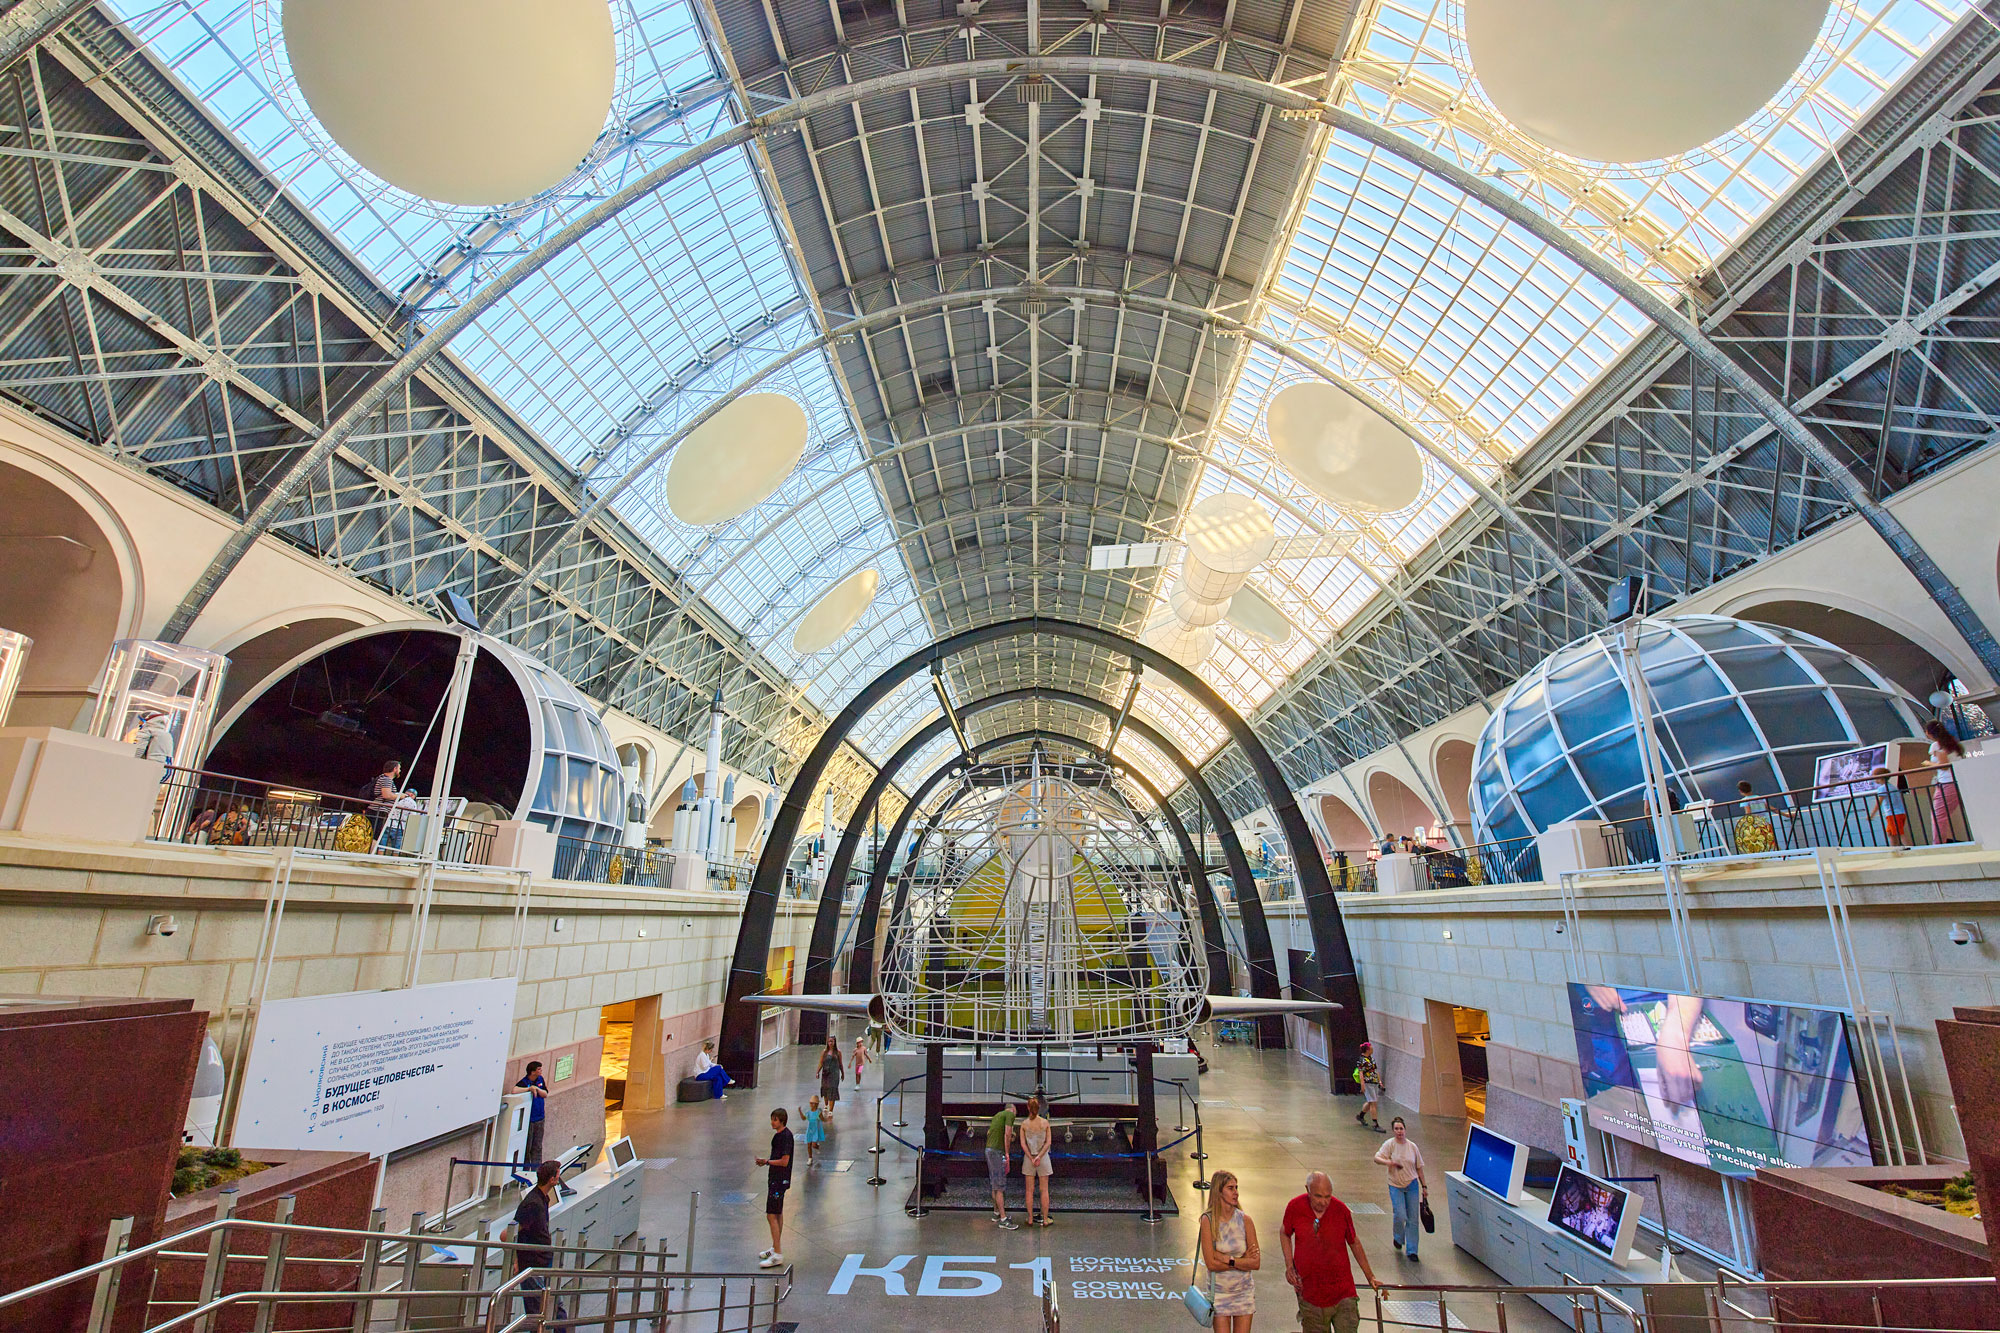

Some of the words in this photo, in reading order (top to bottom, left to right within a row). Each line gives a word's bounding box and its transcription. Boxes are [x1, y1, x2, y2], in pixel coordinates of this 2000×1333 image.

[331, 1050, 340, 1058] ДО
[341, 1046, 358, 1056] ТАКОЙ
[392, 1038, 405, 1046] ДАЖЕ
[406, 1036, 422, 1044] САМАЯ
[332, 1040, 358, 1050] БУДУЩЕЕ
[358, 1033, 395, 1044] ЧЕЛОВЕЧЕСТВА
[328, 1064, 350, 1074] СЛУЧАЕ
[350, 1062, 362, 1070] ОНО
[370, 1055, 398, 1065] ПРЕДЕЛАМИ
[418, 1048, 430, 1056] ДАЖЕ
[343, 1052, 376, 1064] СОСТОЯНИИ
[408, 1042, 422, 1050] ЭТОГО
[324, 1078, 371, 1098] БУДУЩЕЕ
[372, 1064, 435, 1087] ЧЕЛОВЕЧЕСТВА
[327, 1070, 360, 1083] СОЛНЕЧНОЙ
[322, 1104, 330, 1114] В
[332, 1090, 380, 1112] КОСМОСЕ!
[1602, 1113, 1672, 1142] water-purification
[1673, 1137, 1714, 1158] systems,
[1624, 1109, 1652, 1125] Teflon,
[1653, 1120, 1700, 1140] microwave
[1703, 1136, 1734, 1153] ovens,
[1736, 1146, 1767, 1162] metal
[1069, 1256, 1206, 1266] КОСМИЧЕСК
[1070, 1264, 1172, 1273] БУЛЬВАР
[1072, 1280, 1164, 1290] COSMIC
[1073, 1290, 1207, 1300] BOULEVA
